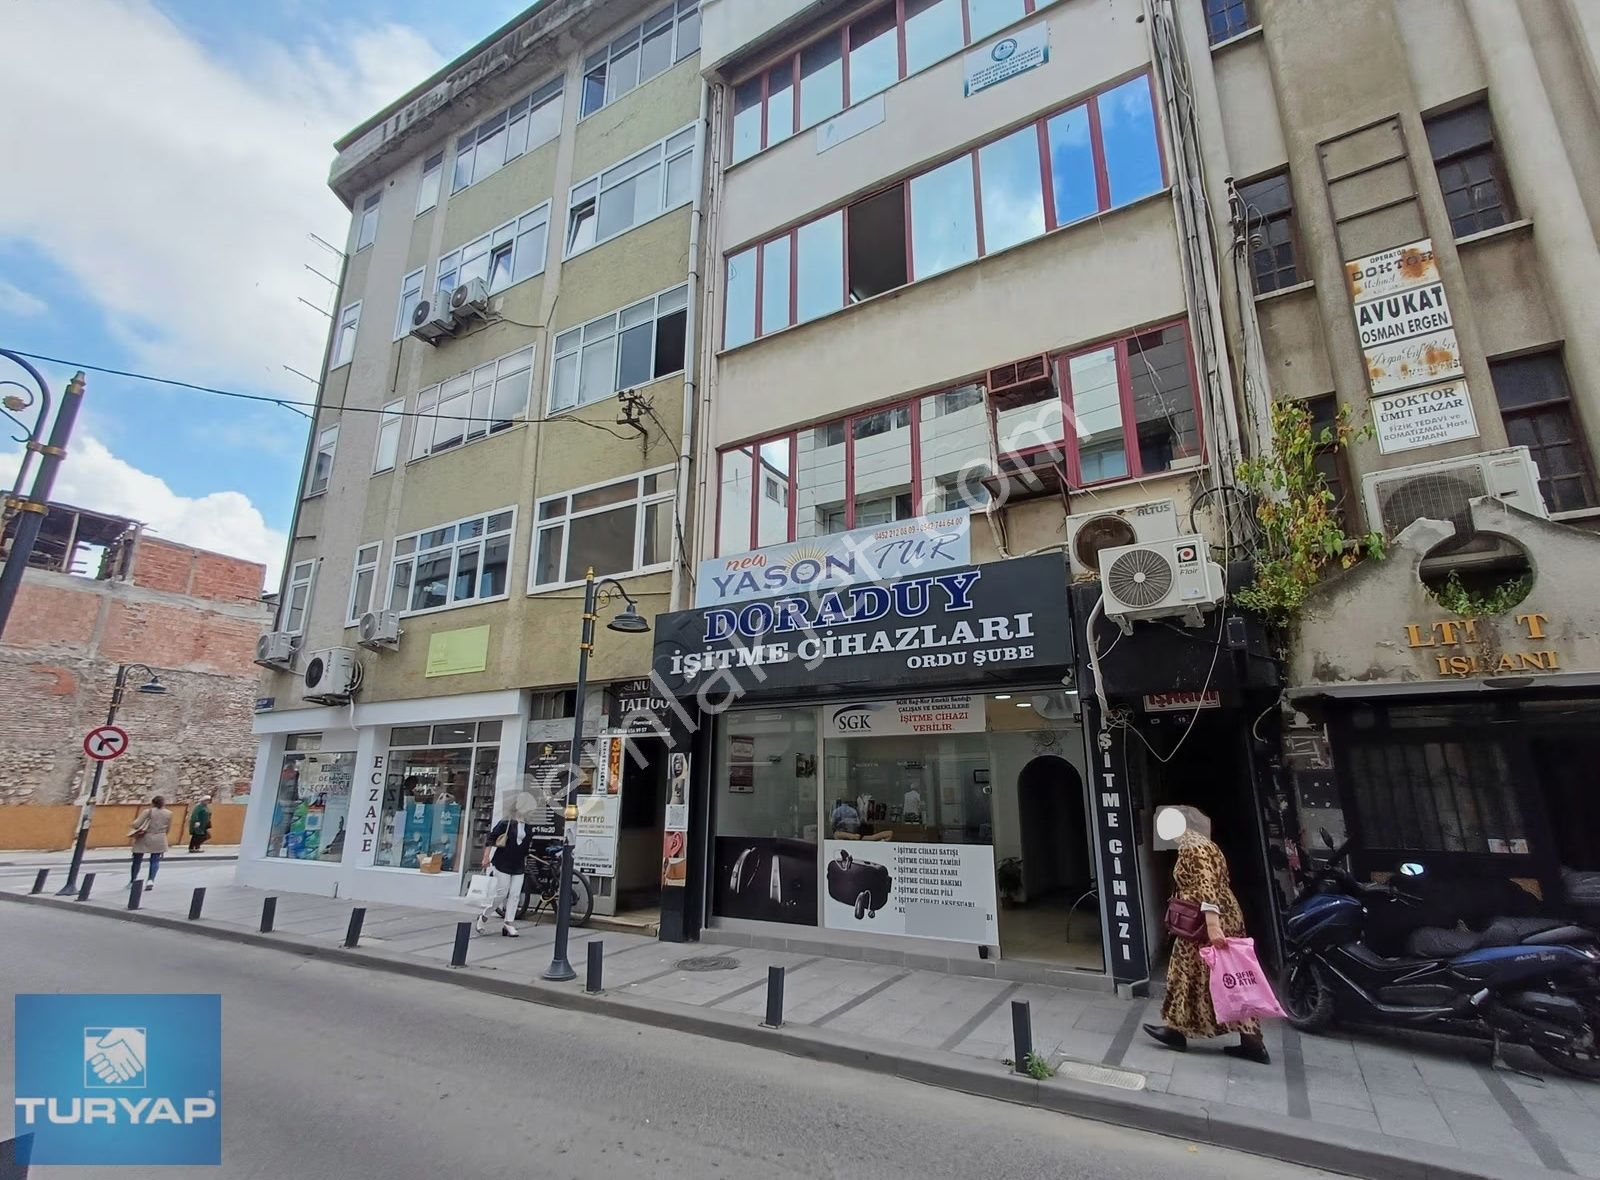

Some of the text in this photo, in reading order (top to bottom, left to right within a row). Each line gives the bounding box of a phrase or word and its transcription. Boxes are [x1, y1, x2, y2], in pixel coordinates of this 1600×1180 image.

[1360, 286, 1442, 326] AVUKAT
[1362, 311, 1448, 344] OSMAN ERGEN
[1380, 399, 1464, 422] ÜMİT HAZAR
[1382, 388, 1457, 411] DOKTOR
[1409, 431, 1447, 444] UZMANI
[1137, 504, 1170, 516] ALTUS
[889, 530, 899, 539] 212
[726, 553, 767, 572] new
[875, 533, 961, 569] TUR
[712, 551, 856, 598] YASON
[703, 571, 981, 643] DORADUY
[670, 613, 1034, 679] İŞİTME CİHAZLARI
[907, 645, 1034, 669] ORDU ŞUBE
[619, 697, 671, 712] TATTOO
[839, 714, 871, 730] SGK
[900, 711, 969, 723] İŞİTME CİHAZI
[913, 721, 952, 732] VERİLİR
[1099, 732, 1120, 827] ŞİTME
[361, 756, 383, 852] ECZANE
[1108, 838, 1130, 960] CİHAZI
